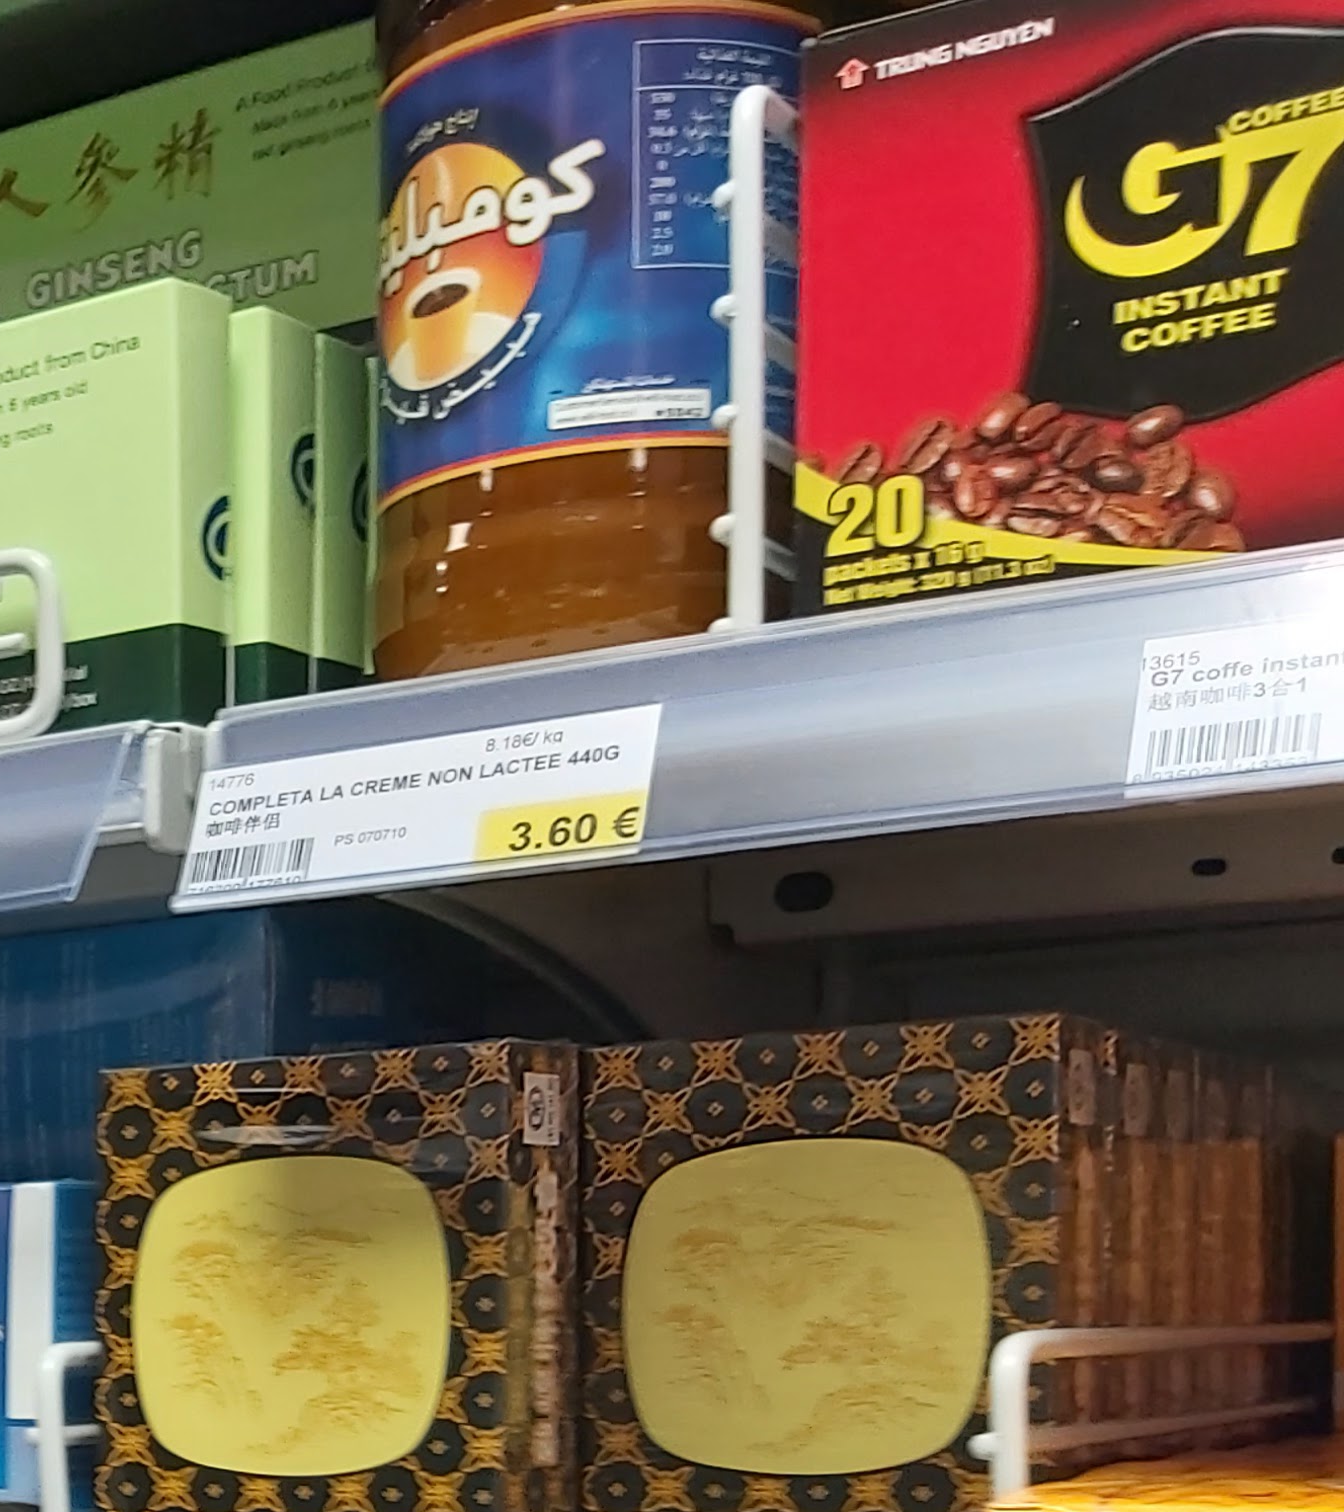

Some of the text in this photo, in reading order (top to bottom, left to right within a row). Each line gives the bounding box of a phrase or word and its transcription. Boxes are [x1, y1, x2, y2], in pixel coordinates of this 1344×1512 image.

[26, 229, 204, 312] GINSENG
[1113, 267, 1290, 325] INSTANT
[1121, 302, 1277, 354] COFFEE
[43, 349, 88, 374] from
[88, 334, 142, 361] China
[20, 387, 62, 411] years
[63, 379, 90, 399] old
[824, 474, 924, 558] 20
[1141, 650, 1201, 673] 13615
[1150, 669, 1184, 687] G7
[1192, 661, 1254, 683] coffe
[485, 730, 539, 753] 8.18€/
[208, 744, 621, 817] COMPLETA LA CREME NON LACTEE 440G
[208, 772, 256, 793] 14776
[333, 832, 354, 848] PS
[507, 805, 641, 853] 3.60 €
